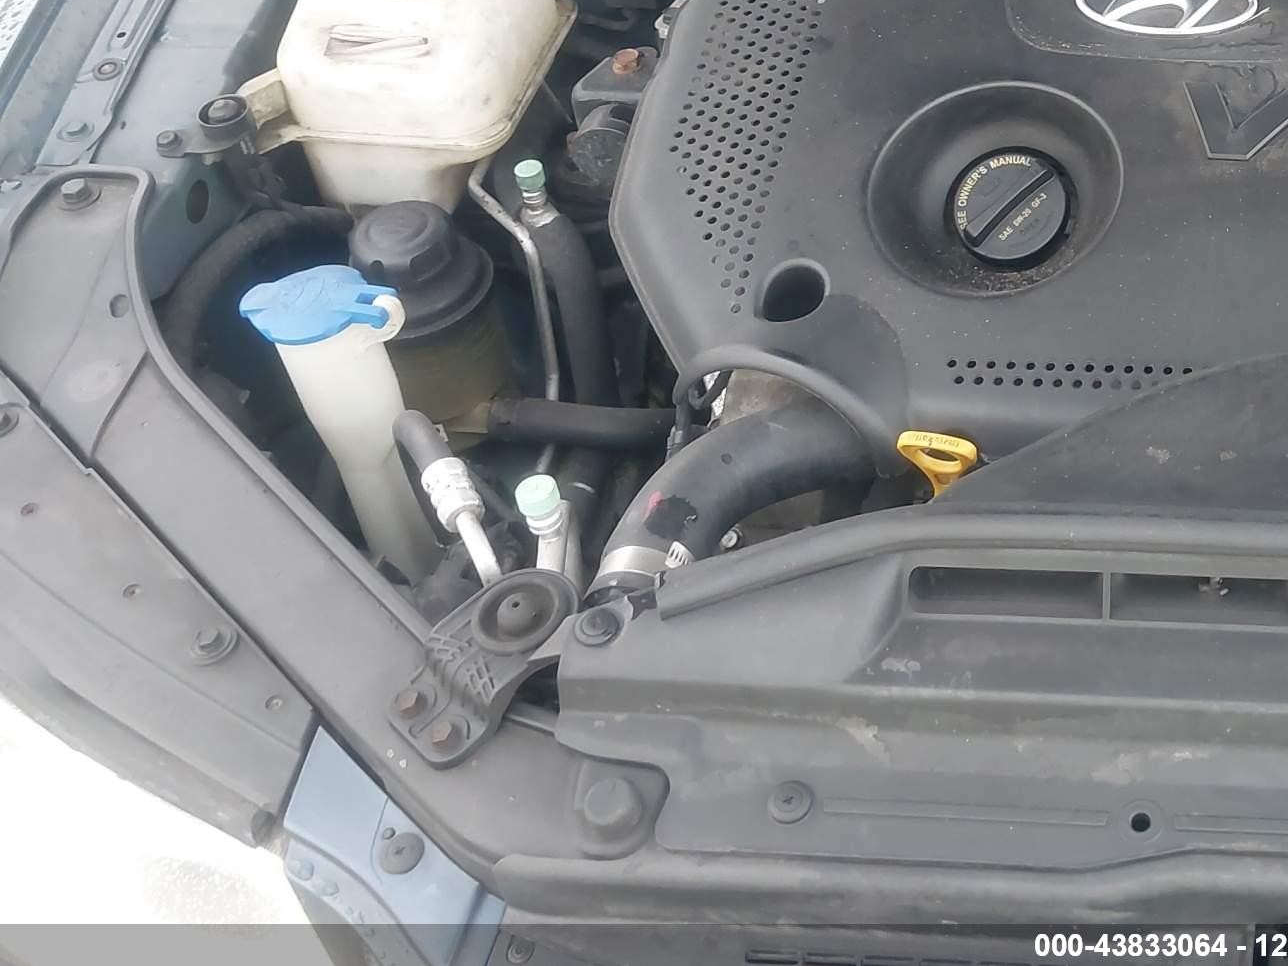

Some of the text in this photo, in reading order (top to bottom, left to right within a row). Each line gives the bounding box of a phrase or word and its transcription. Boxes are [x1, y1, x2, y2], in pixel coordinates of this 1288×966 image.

[957, 155, 1031, 230] SEE OWNER'S MANUAL
[998, 227, 1014, 240] SAE
